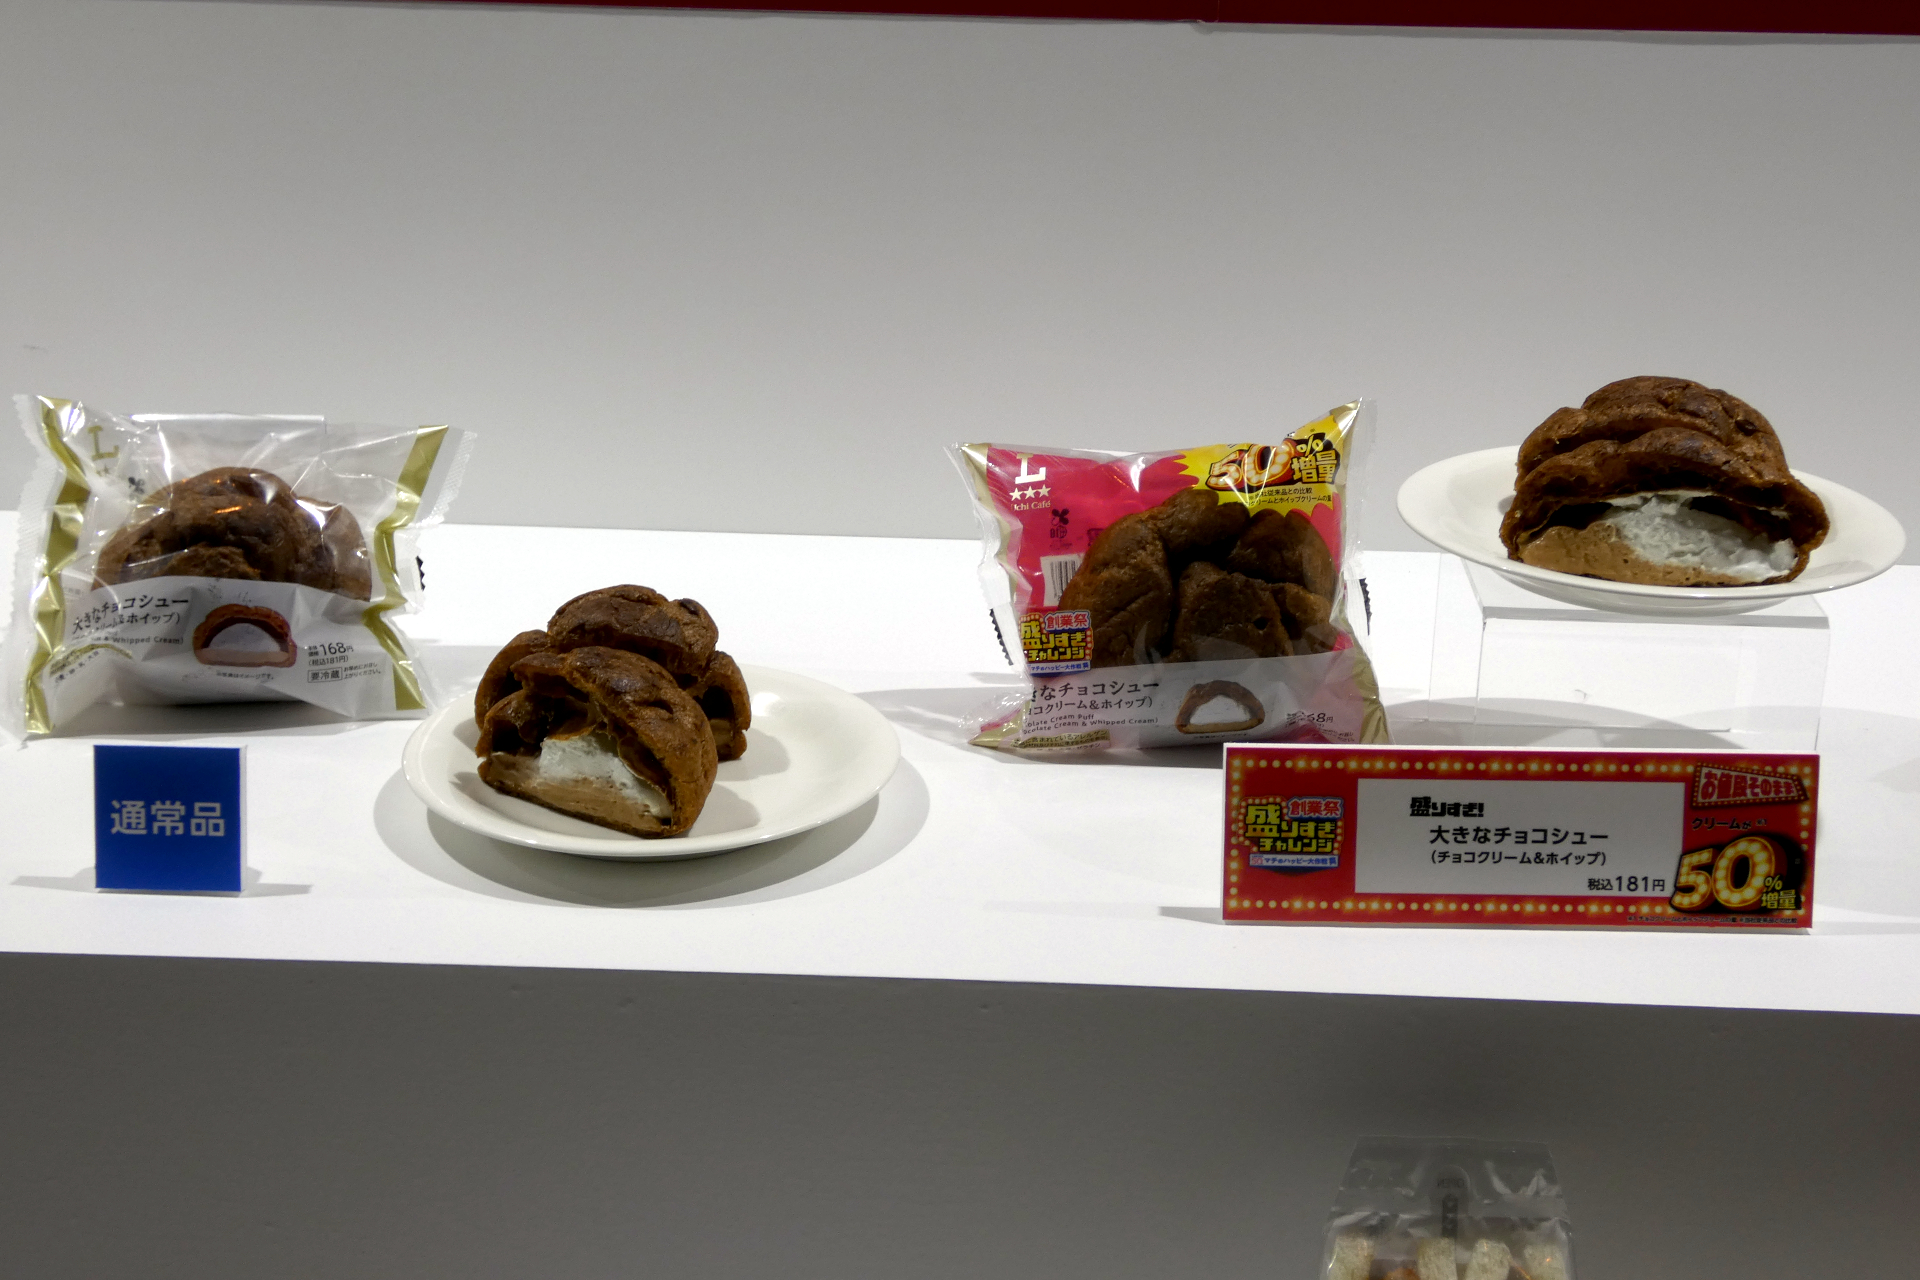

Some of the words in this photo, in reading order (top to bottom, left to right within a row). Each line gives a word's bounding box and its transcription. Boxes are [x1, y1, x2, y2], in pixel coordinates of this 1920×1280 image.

[1015, 453, 1046, 484] L
[1045, 612, 1089, 629] 創業祭
[1020, 620, 1087, 650] 盛りすぎ
[1028, 646, 1085, 662] チャレンジ
[310, 669, 341, 681] 要冷蔵
[1089, 717, 1126, 727] Whipped
[1128, 717, 1159, 725] Cream)
[1289, 799, 1341, 817] 創業祭
[1409, 796, 1485, 818] 盛りすぎ!
[110, 799, 225, 838] 通常品
[1245, 804, 1336, 838] 盛りすぎ
[1692, 817, 1752, 831] クリームが
[1429, 825, 1609, 845] 大きなチョコシュー
[1259, 838, 1333, 853] チャレンジ
[1430, 850, 1607, 866] (チョコクリーム&ホイップ)
[1588, 875, 1666, 893] 税込181円
